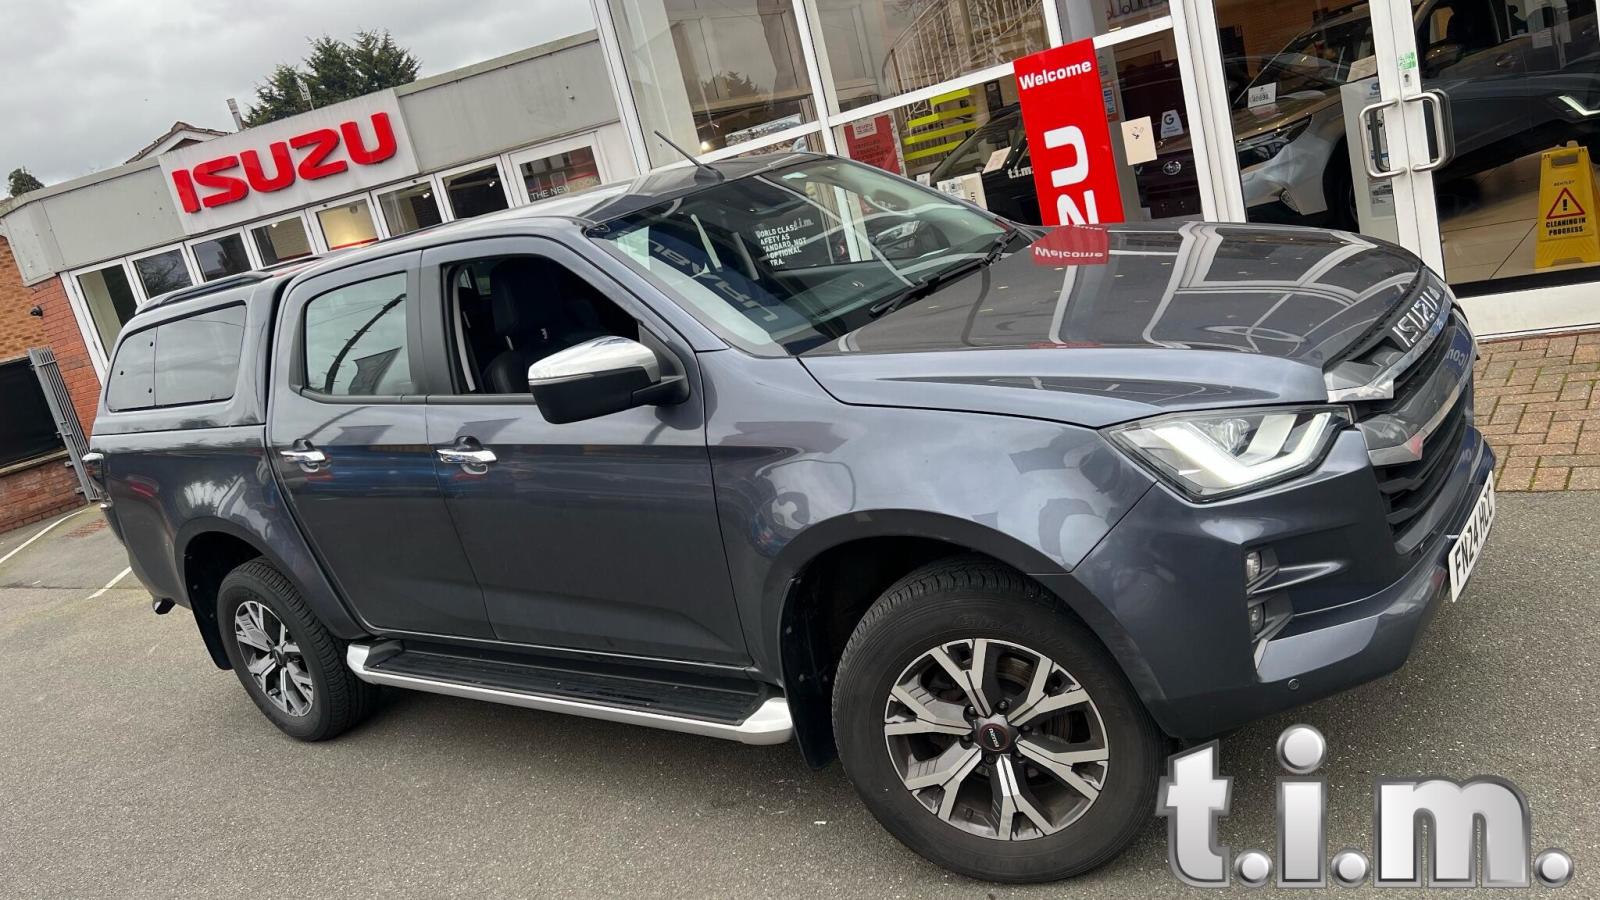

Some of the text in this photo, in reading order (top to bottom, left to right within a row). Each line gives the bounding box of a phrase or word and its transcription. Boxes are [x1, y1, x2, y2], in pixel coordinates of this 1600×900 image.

[1019, 61, 1092, 90] Welcome
[172, 112, 398, 213] ISUZU
[531, 191, 549, 200] THE
[550, 184, 571, 196] NEW
[1546, 219, 1578, 228] CLEANING
[1549, 226, 1583, 236] PROGRESS
[760, 235, 780, 245] AFETY
[1392, 291, 1439, 348] ISUZU
[1455, 515, 1479, 586] FN24
